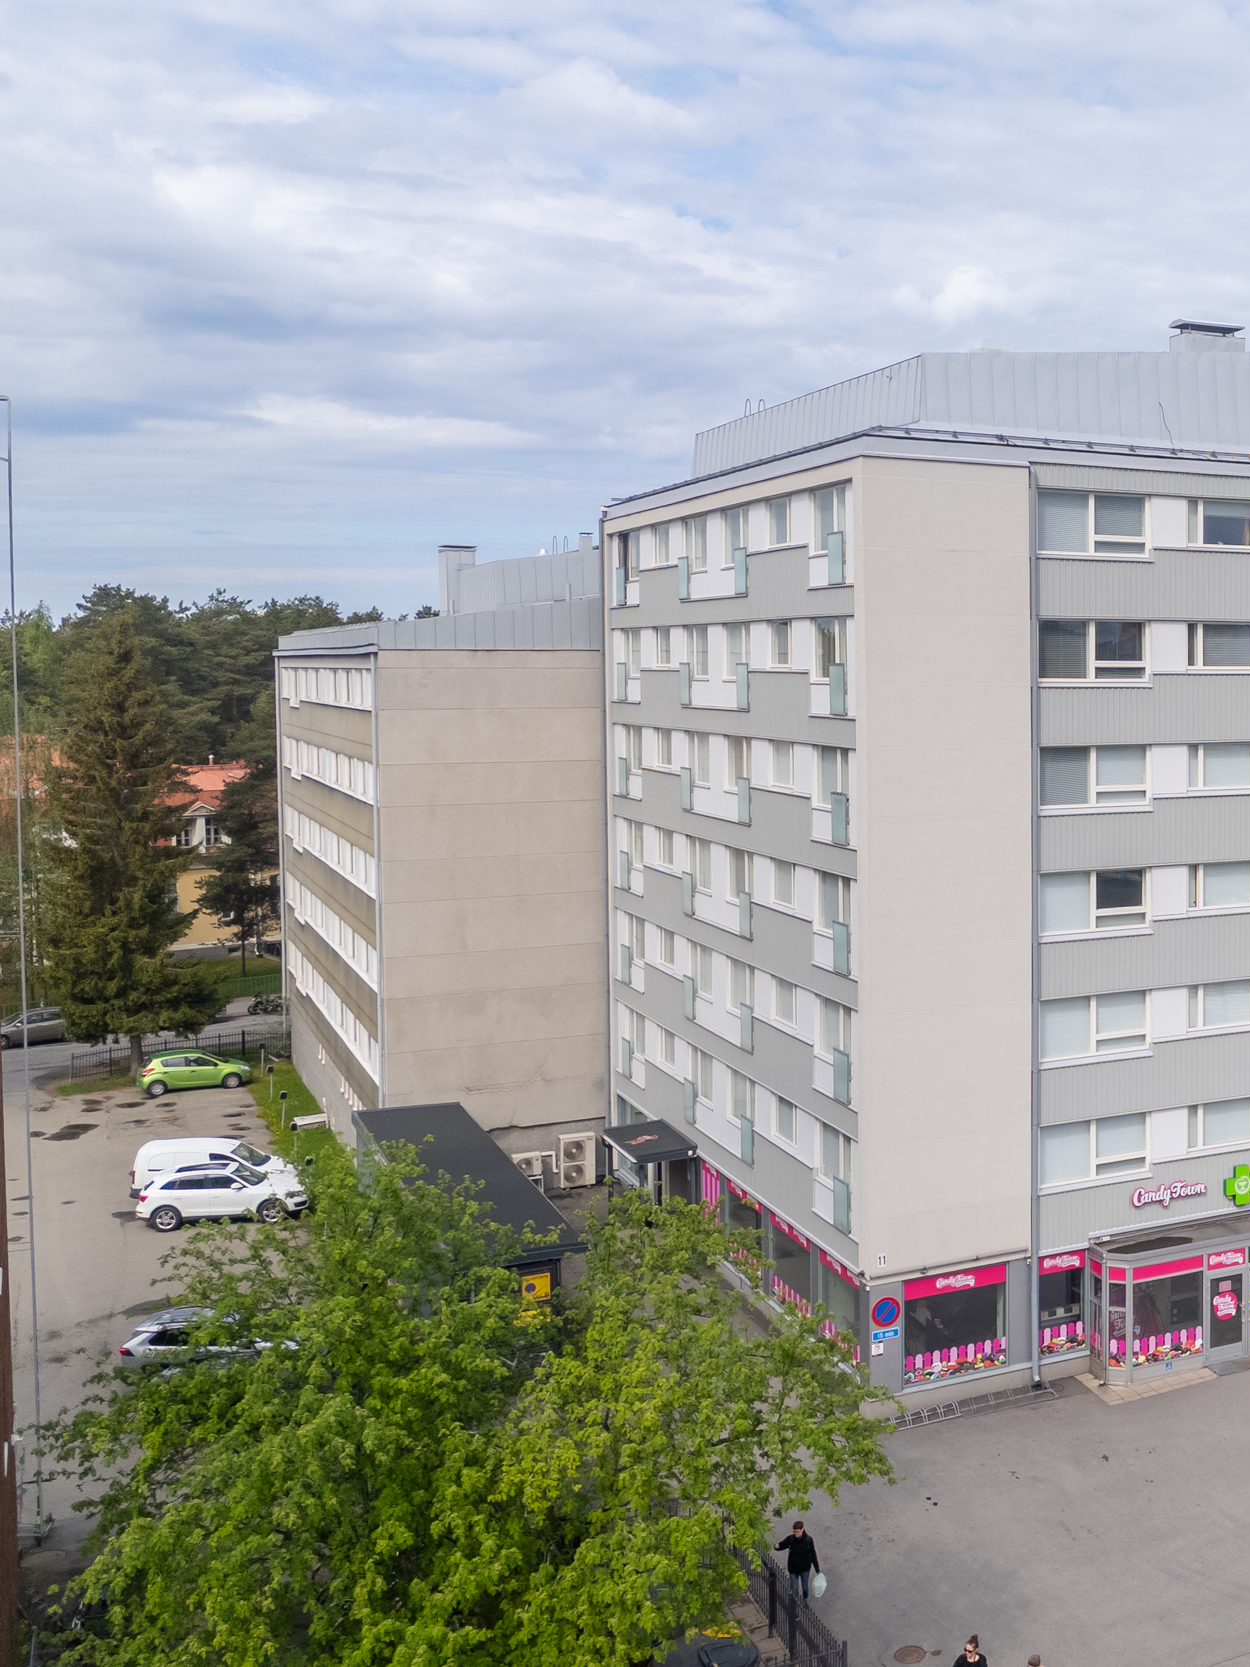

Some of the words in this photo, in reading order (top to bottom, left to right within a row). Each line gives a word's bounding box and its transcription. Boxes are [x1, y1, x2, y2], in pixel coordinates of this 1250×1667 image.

[1132, 1185, 1172, 1208] Candy
[1170, 1179, 1207, 1198] Town
[878, 1255, 886, 1266] 11
